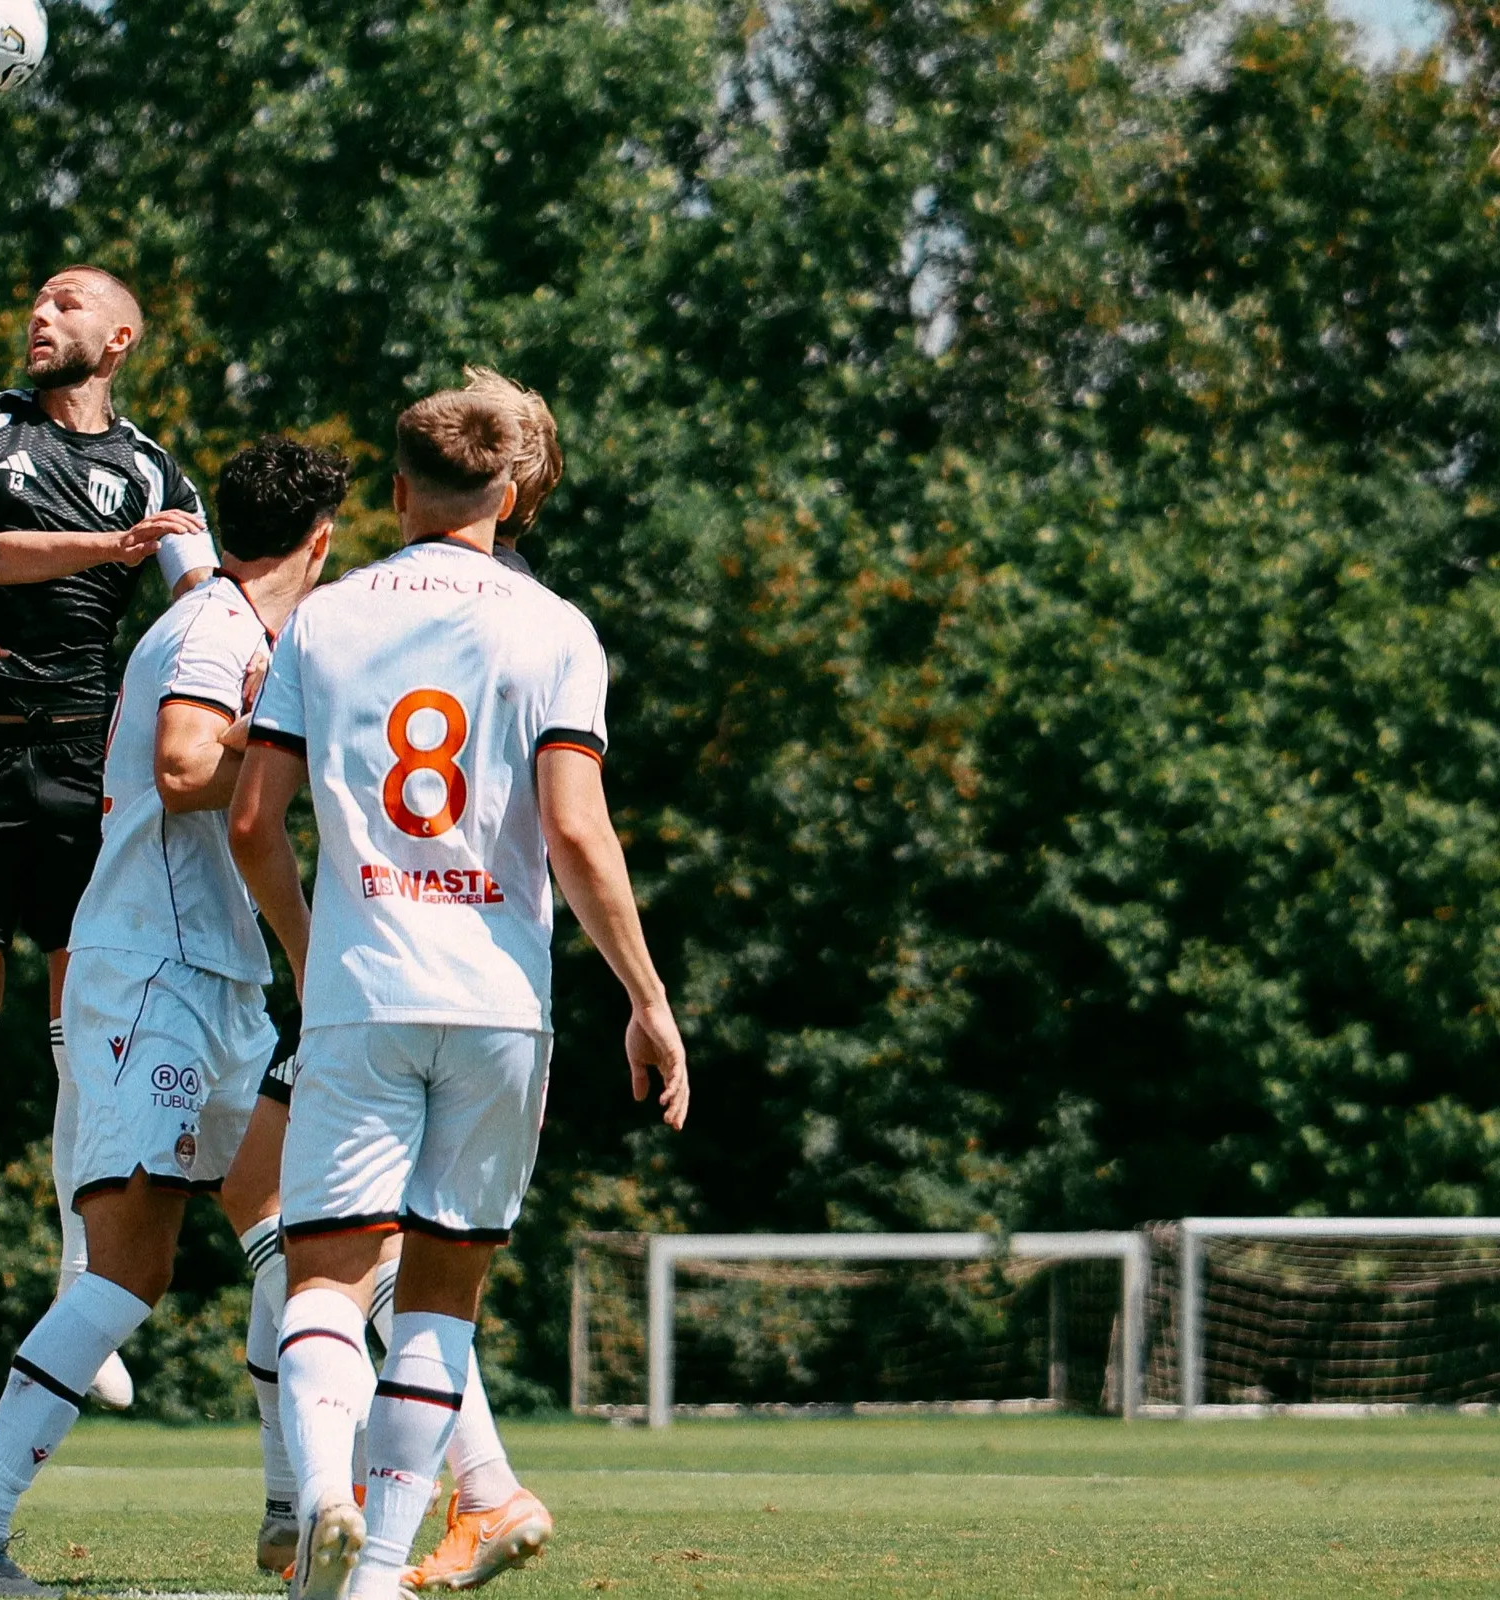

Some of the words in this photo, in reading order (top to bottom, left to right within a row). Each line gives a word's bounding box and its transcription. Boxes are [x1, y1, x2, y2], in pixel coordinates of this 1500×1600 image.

[9, 471, 25, 491] 13
[370, 571, 513, 598] Frasers
[382, 687, 469, 839] 8
[363, 876, 393, 898] EIS
[393, 868, 505, 905] WASTE
[422, 893, 483, 905] SERVICES
[369, 1467, 414, 1485] AFC
